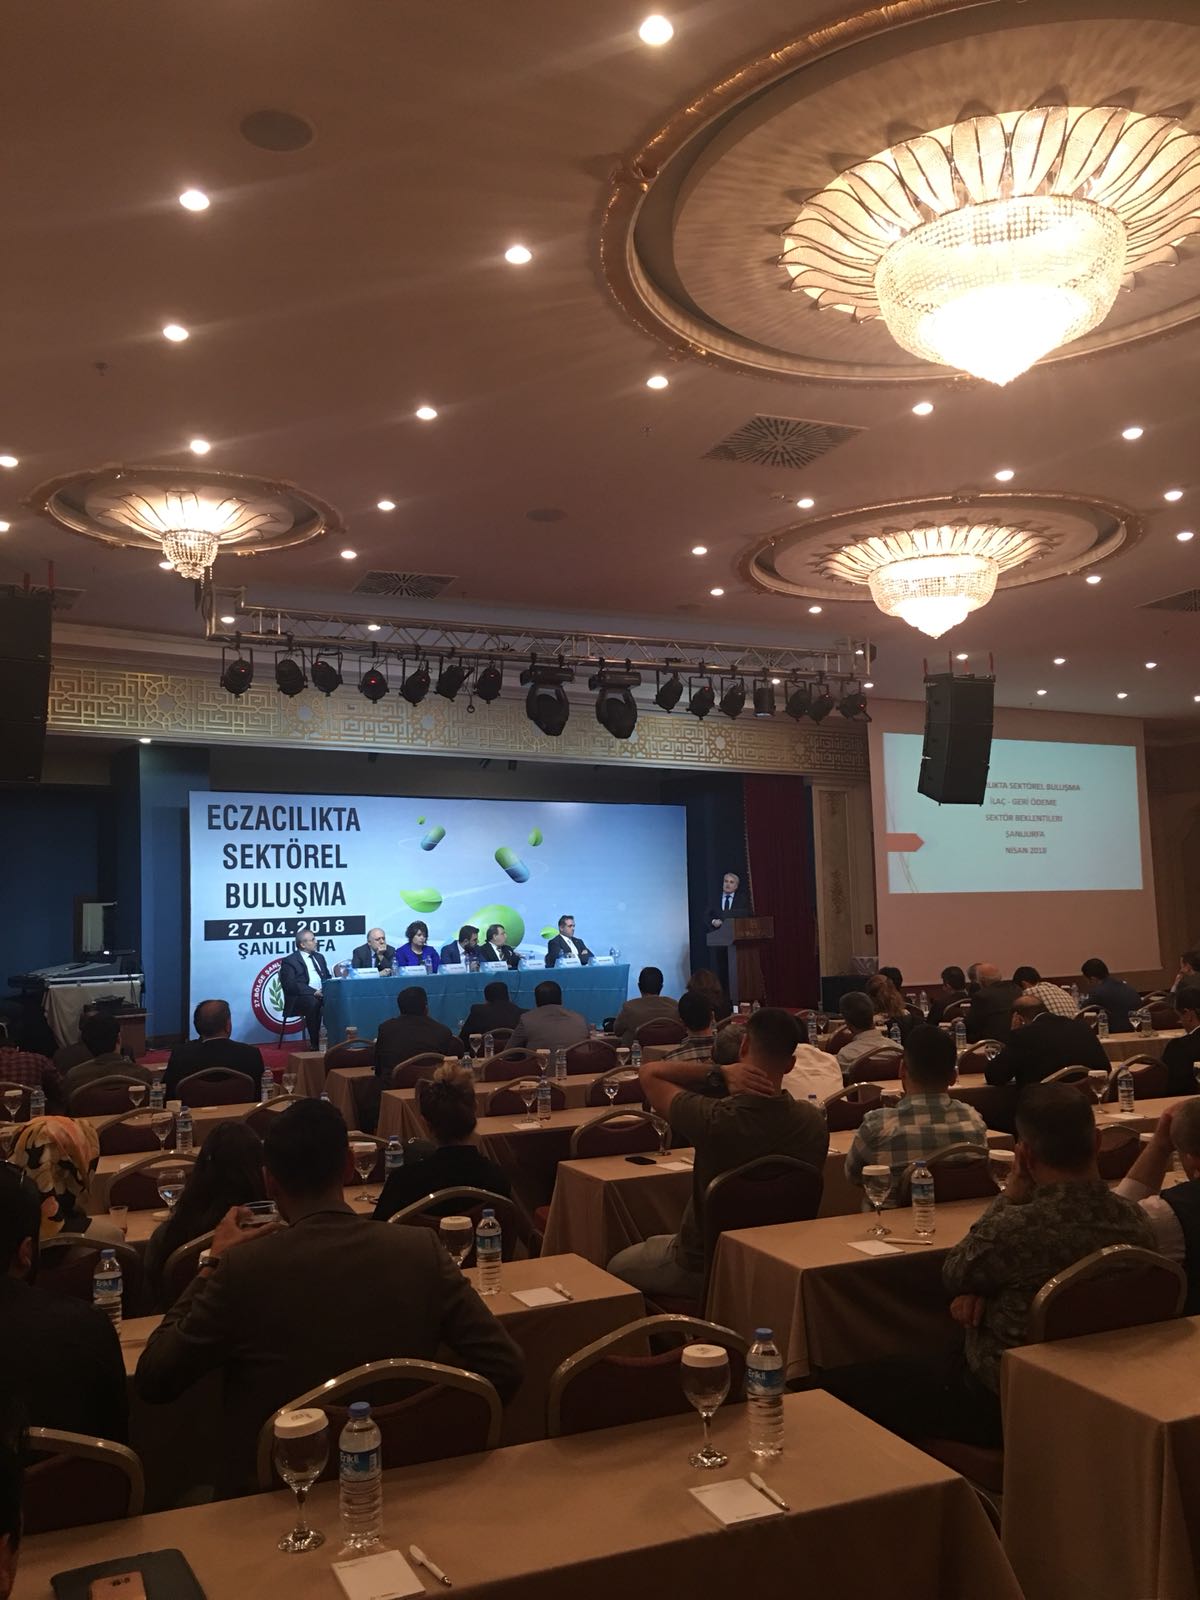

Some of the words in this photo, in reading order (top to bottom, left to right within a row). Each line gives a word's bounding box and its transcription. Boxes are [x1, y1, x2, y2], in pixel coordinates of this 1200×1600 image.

[1046, 783, 1081, 792] BULUŞMA
[207, 804, 361, 832] ECZACILIKTA
[985, 813, 1013, 821] SEKTÖR
[222, 838, 348, 870] SEKTÖREL
[225, 881, 347, 914] BULUŞMA
[228, 919, 345, 937] 27.04.2018
[238, 939, 336, 960] ŞANLIFA
